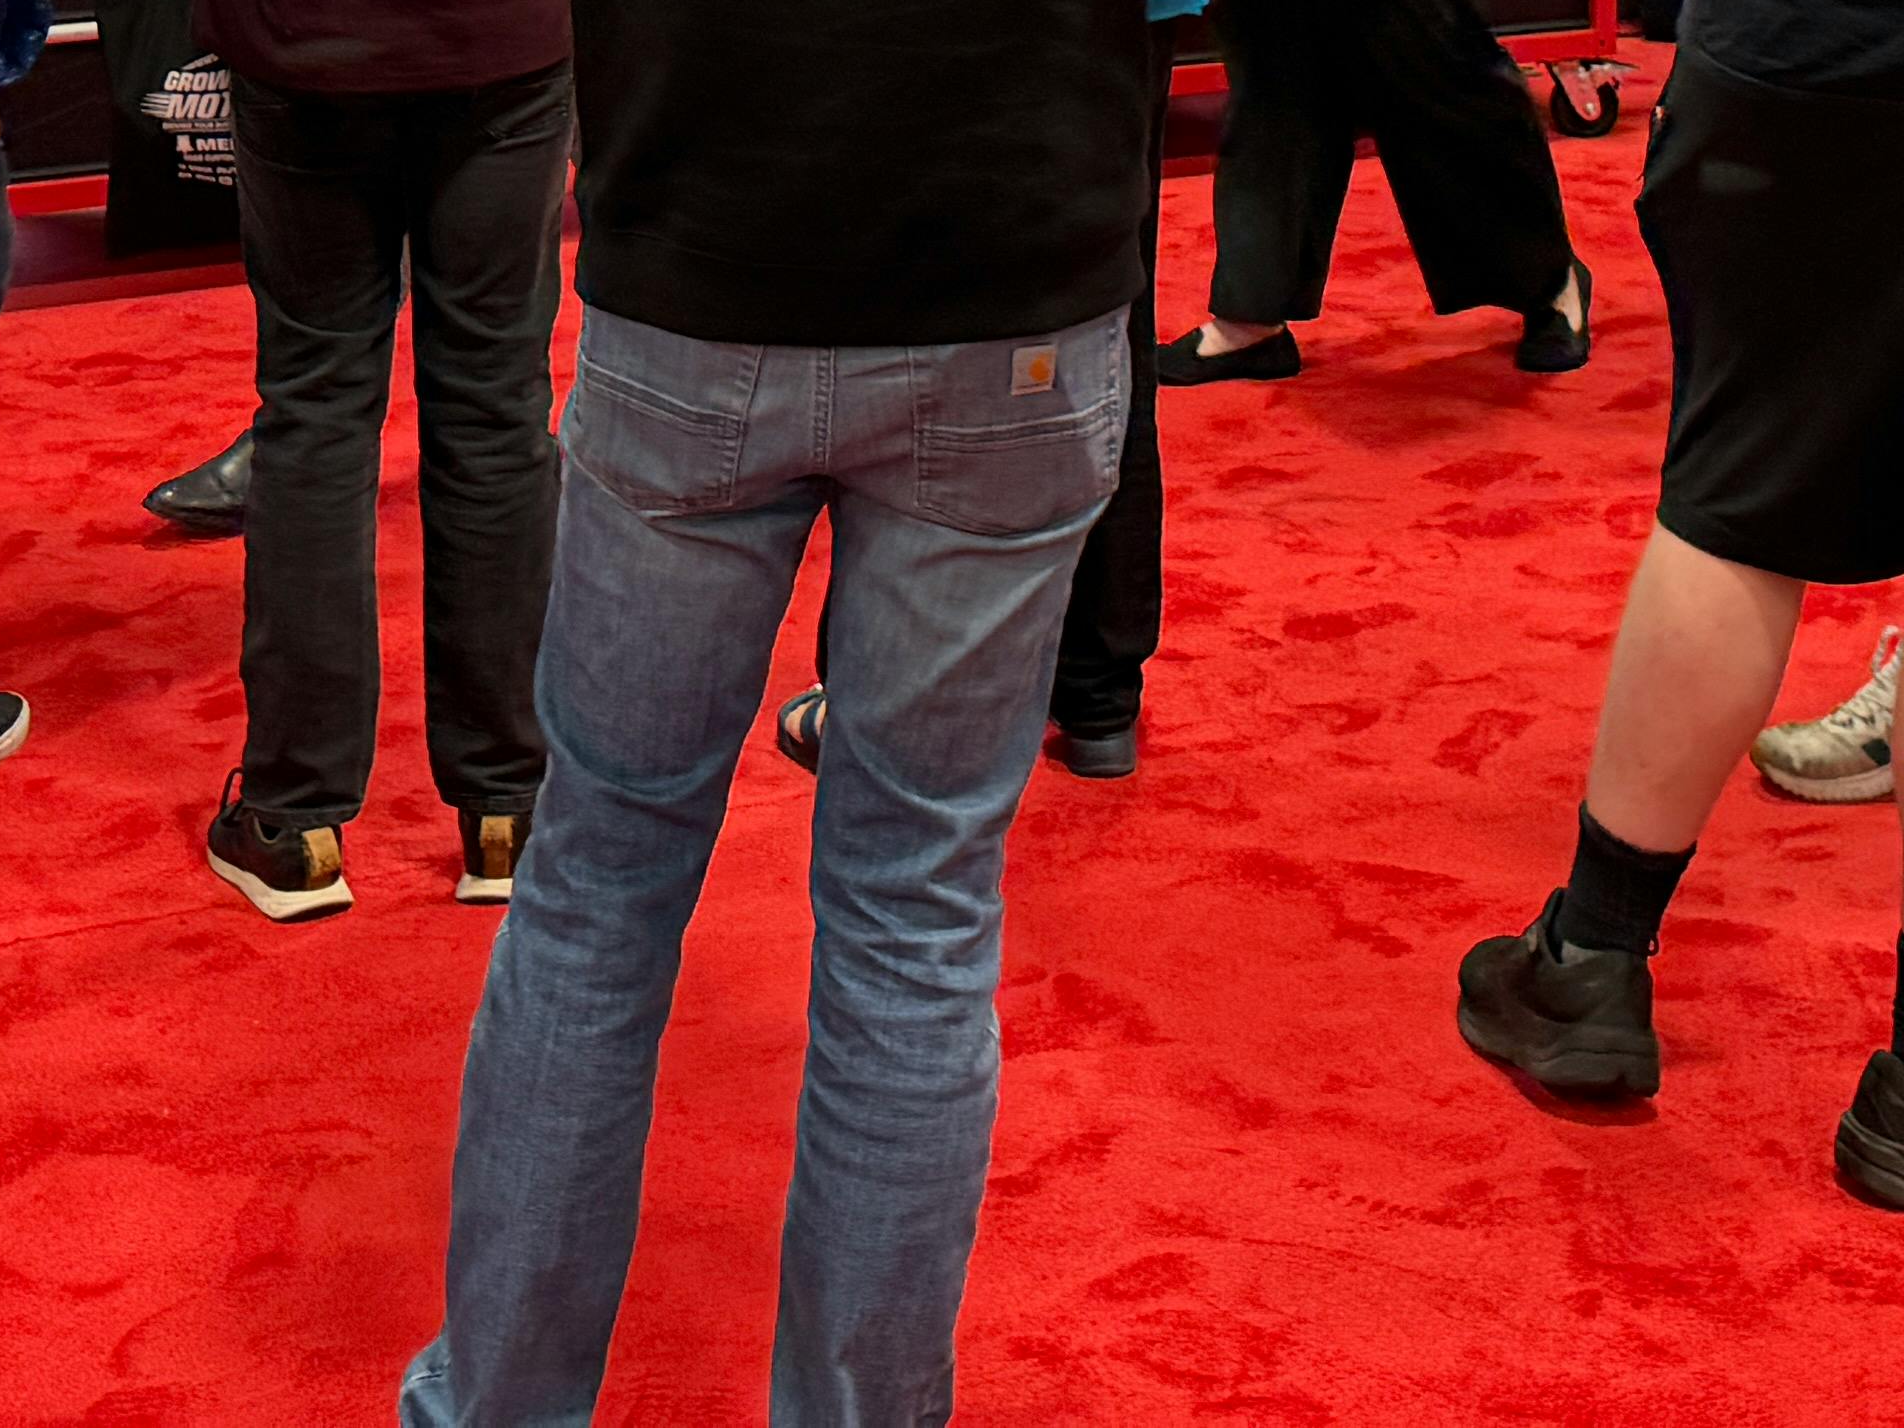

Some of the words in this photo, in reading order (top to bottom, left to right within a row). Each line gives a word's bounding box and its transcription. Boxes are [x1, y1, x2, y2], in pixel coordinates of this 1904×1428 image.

[163, 69, 232, 92] GROW
[167, 93, 231, 120] MOT
[195, 138, 234, 152] ME
